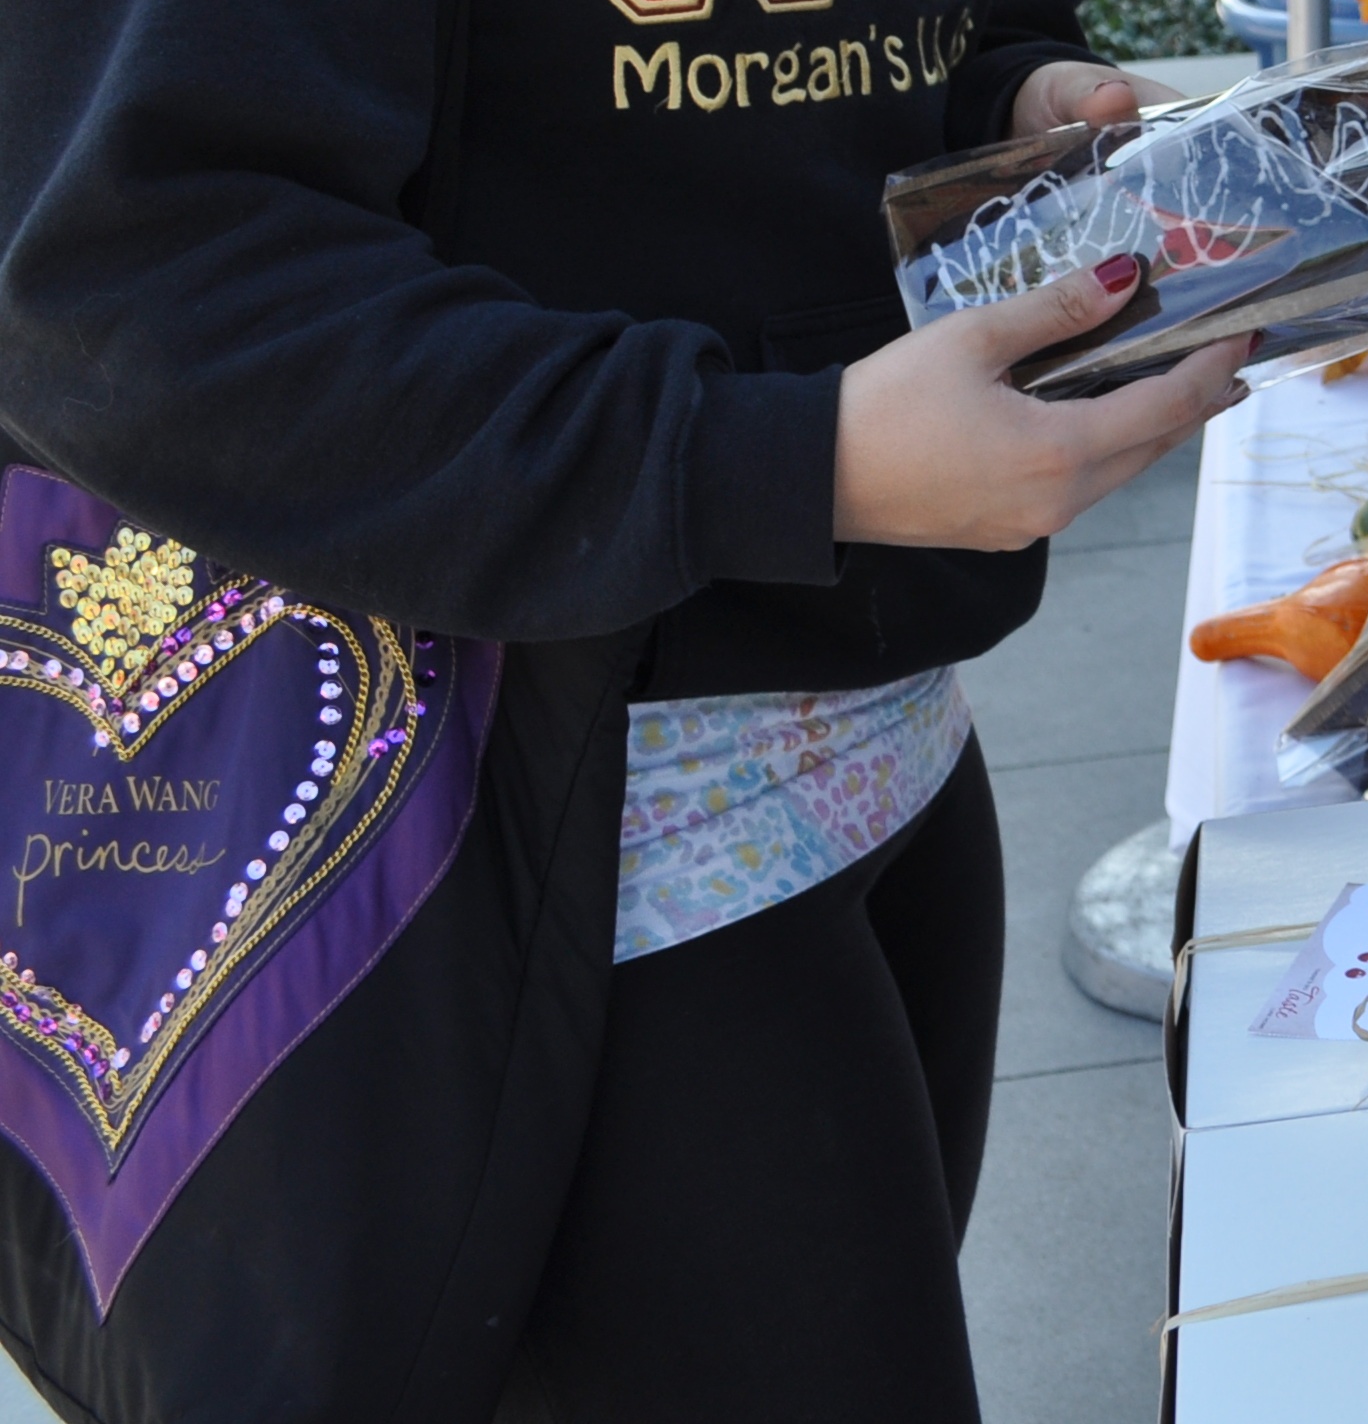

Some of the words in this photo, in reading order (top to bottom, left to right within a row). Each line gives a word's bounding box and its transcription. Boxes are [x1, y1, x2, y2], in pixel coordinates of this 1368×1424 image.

[613, 24, 912, 112] Morgan's
[45, 779, 121, 816] VERA
[126, 775, 221, 812] WANG
